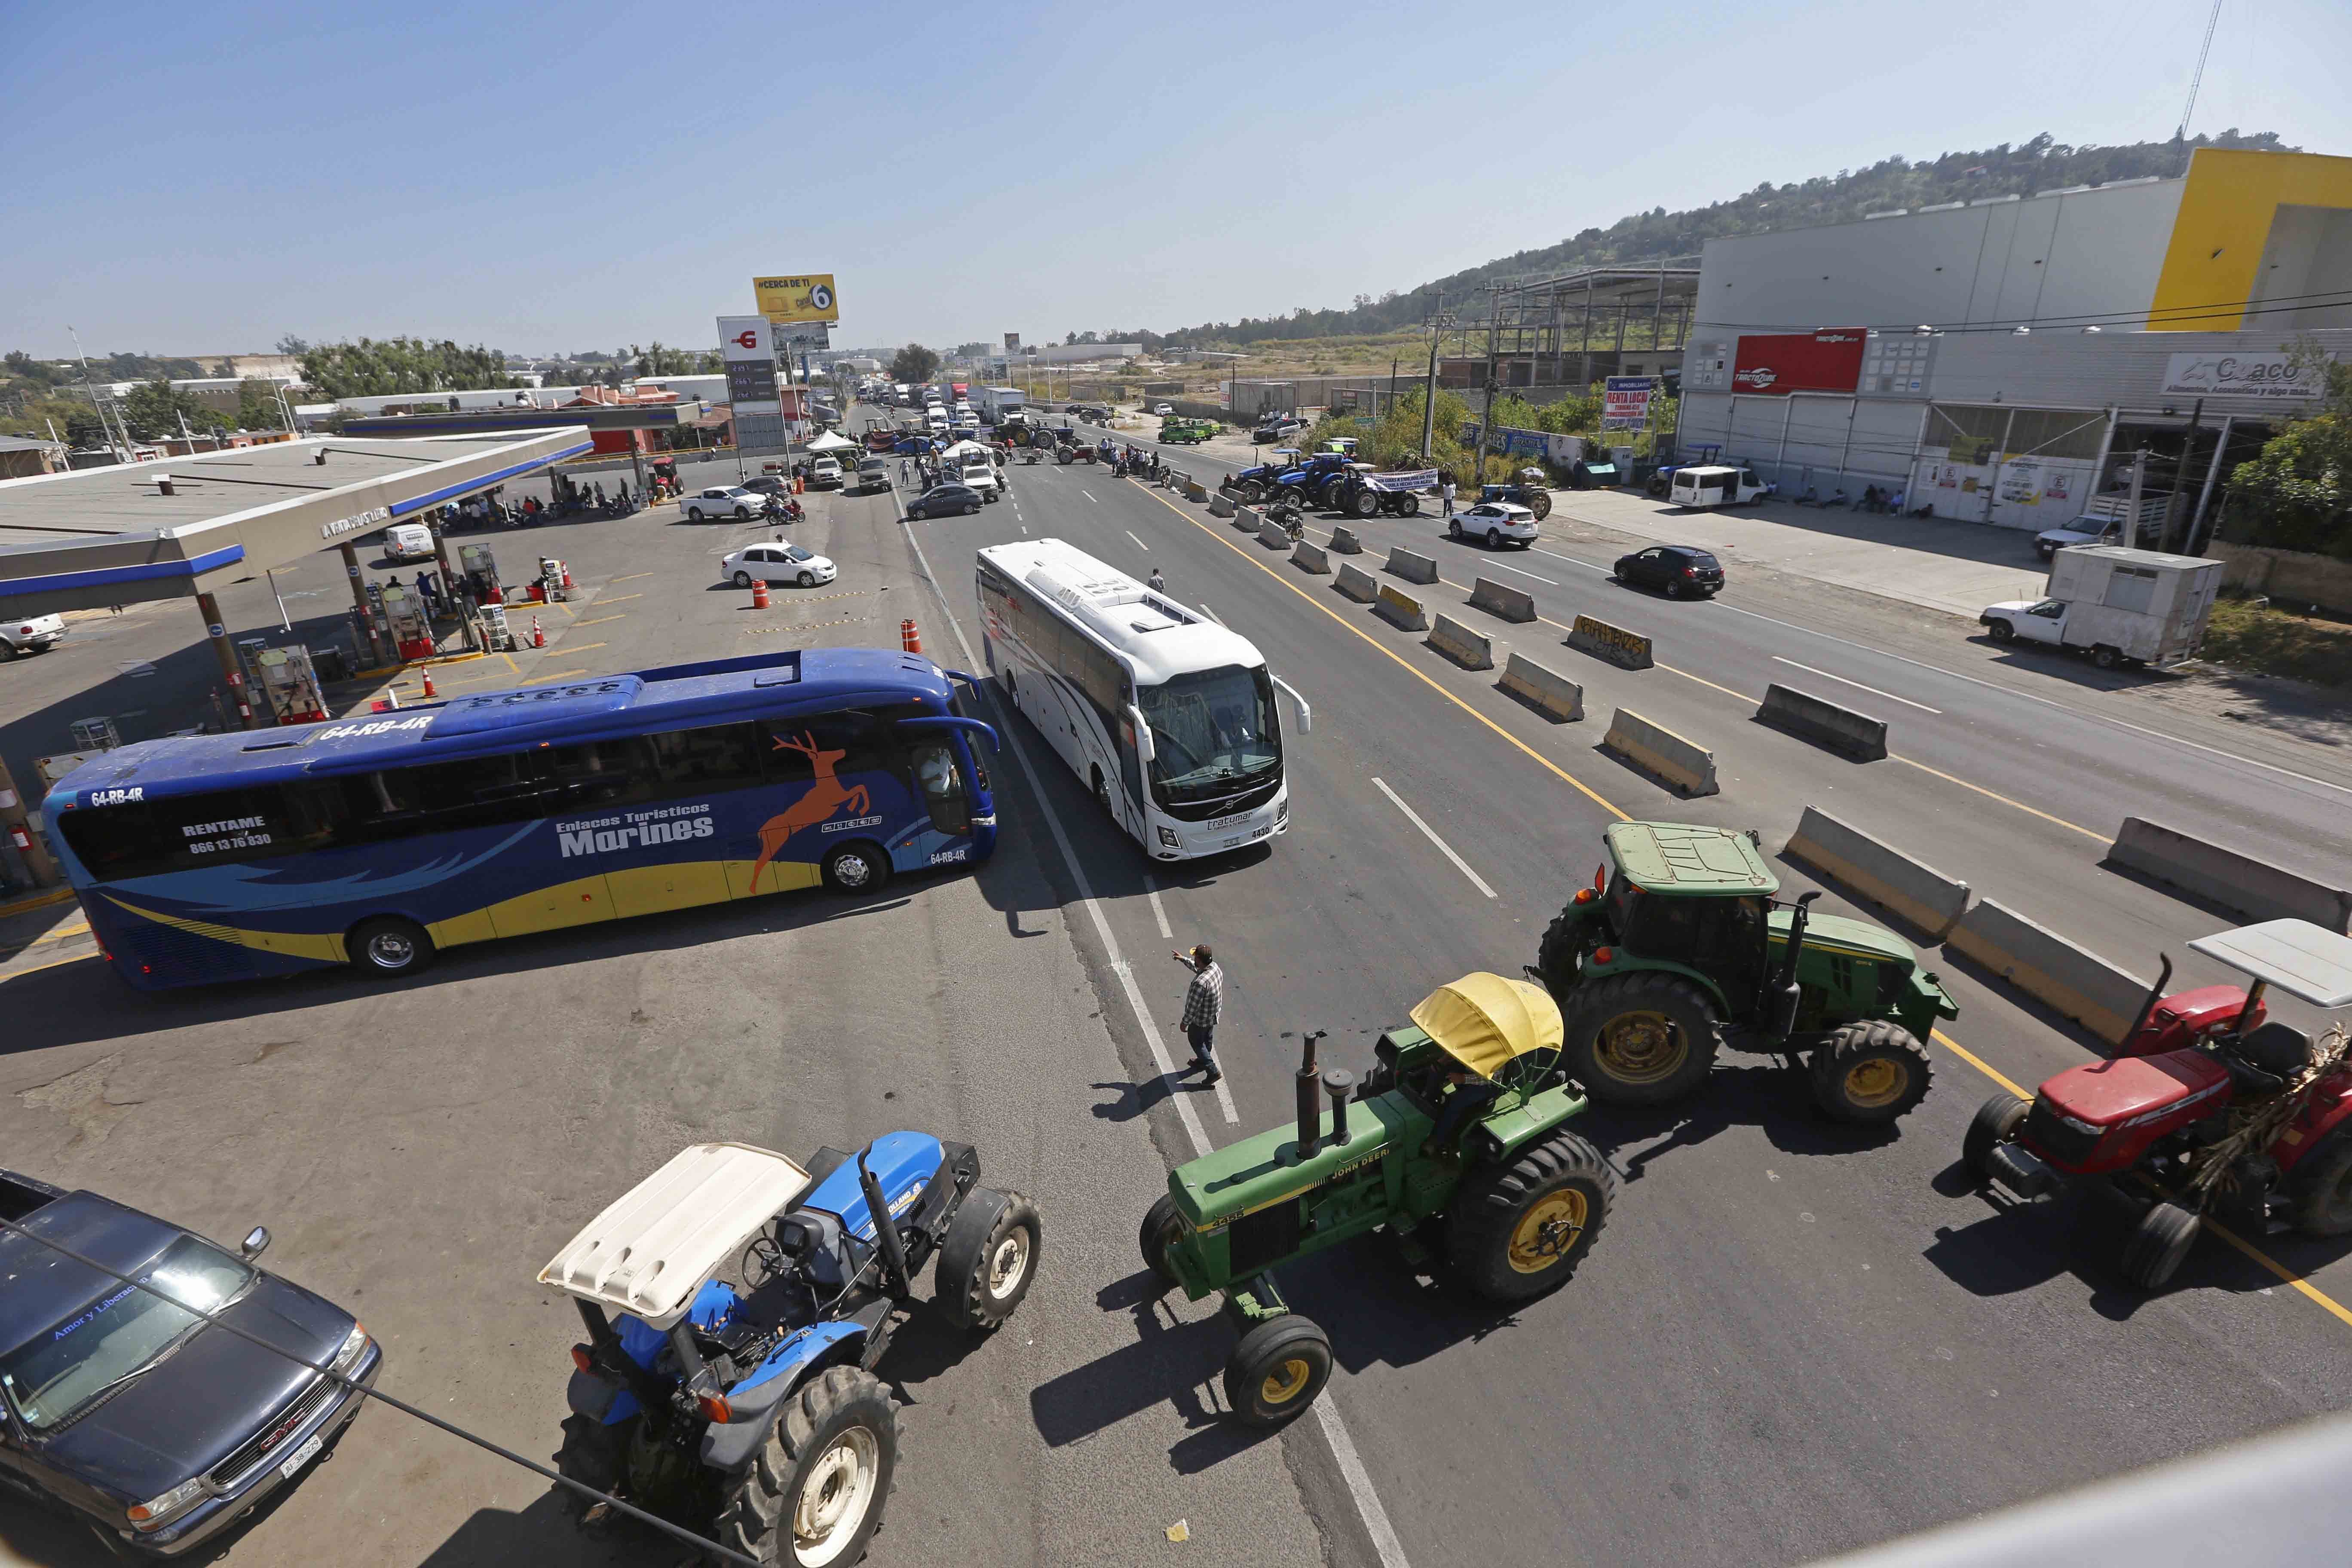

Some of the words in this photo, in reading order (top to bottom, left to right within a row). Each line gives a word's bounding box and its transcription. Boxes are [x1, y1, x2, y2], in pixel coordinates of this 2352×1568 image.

[791, 279, 801, 288] DE
[802, 279, 810, 287] TI
[1607, 392, 1628, 404] RENTA
[319, 716, 433, 740] 64-RB-4R
[92, 787, 144, 807] 64-RB-4R
[182, 816, 265, 836] RENTAME
[556, 817, 620, 833] Enlaces
[625, 803, 709, 823] Turisticos
[1207, 812, 1253, 830] tratumar
[190, 841, 215, 854] 866
[215, 839, 231, 850] 13
[230, 837, 246, 848] 76
[247, 833, 271, 846] 830
[559, 816, 714, 858] Marines
[1252, 827, 1269, 839] 4430
[931, 849, 966, 864] 64-RB-4R
[1332, 1162, 1359, 1179] JOHN
[1362, 1149, 1390, 1166] DEER
[887, 1191, 911, 1212] OLLAND
[55, 1317, 86, 1341] Amor
[86, 1311, 94, 1321] y
[95, 1277, 150, 1313] Liberacin
[260, 1408, 306, 1451] GMC
[285, 1439, 319, 1475] JU-38-229
